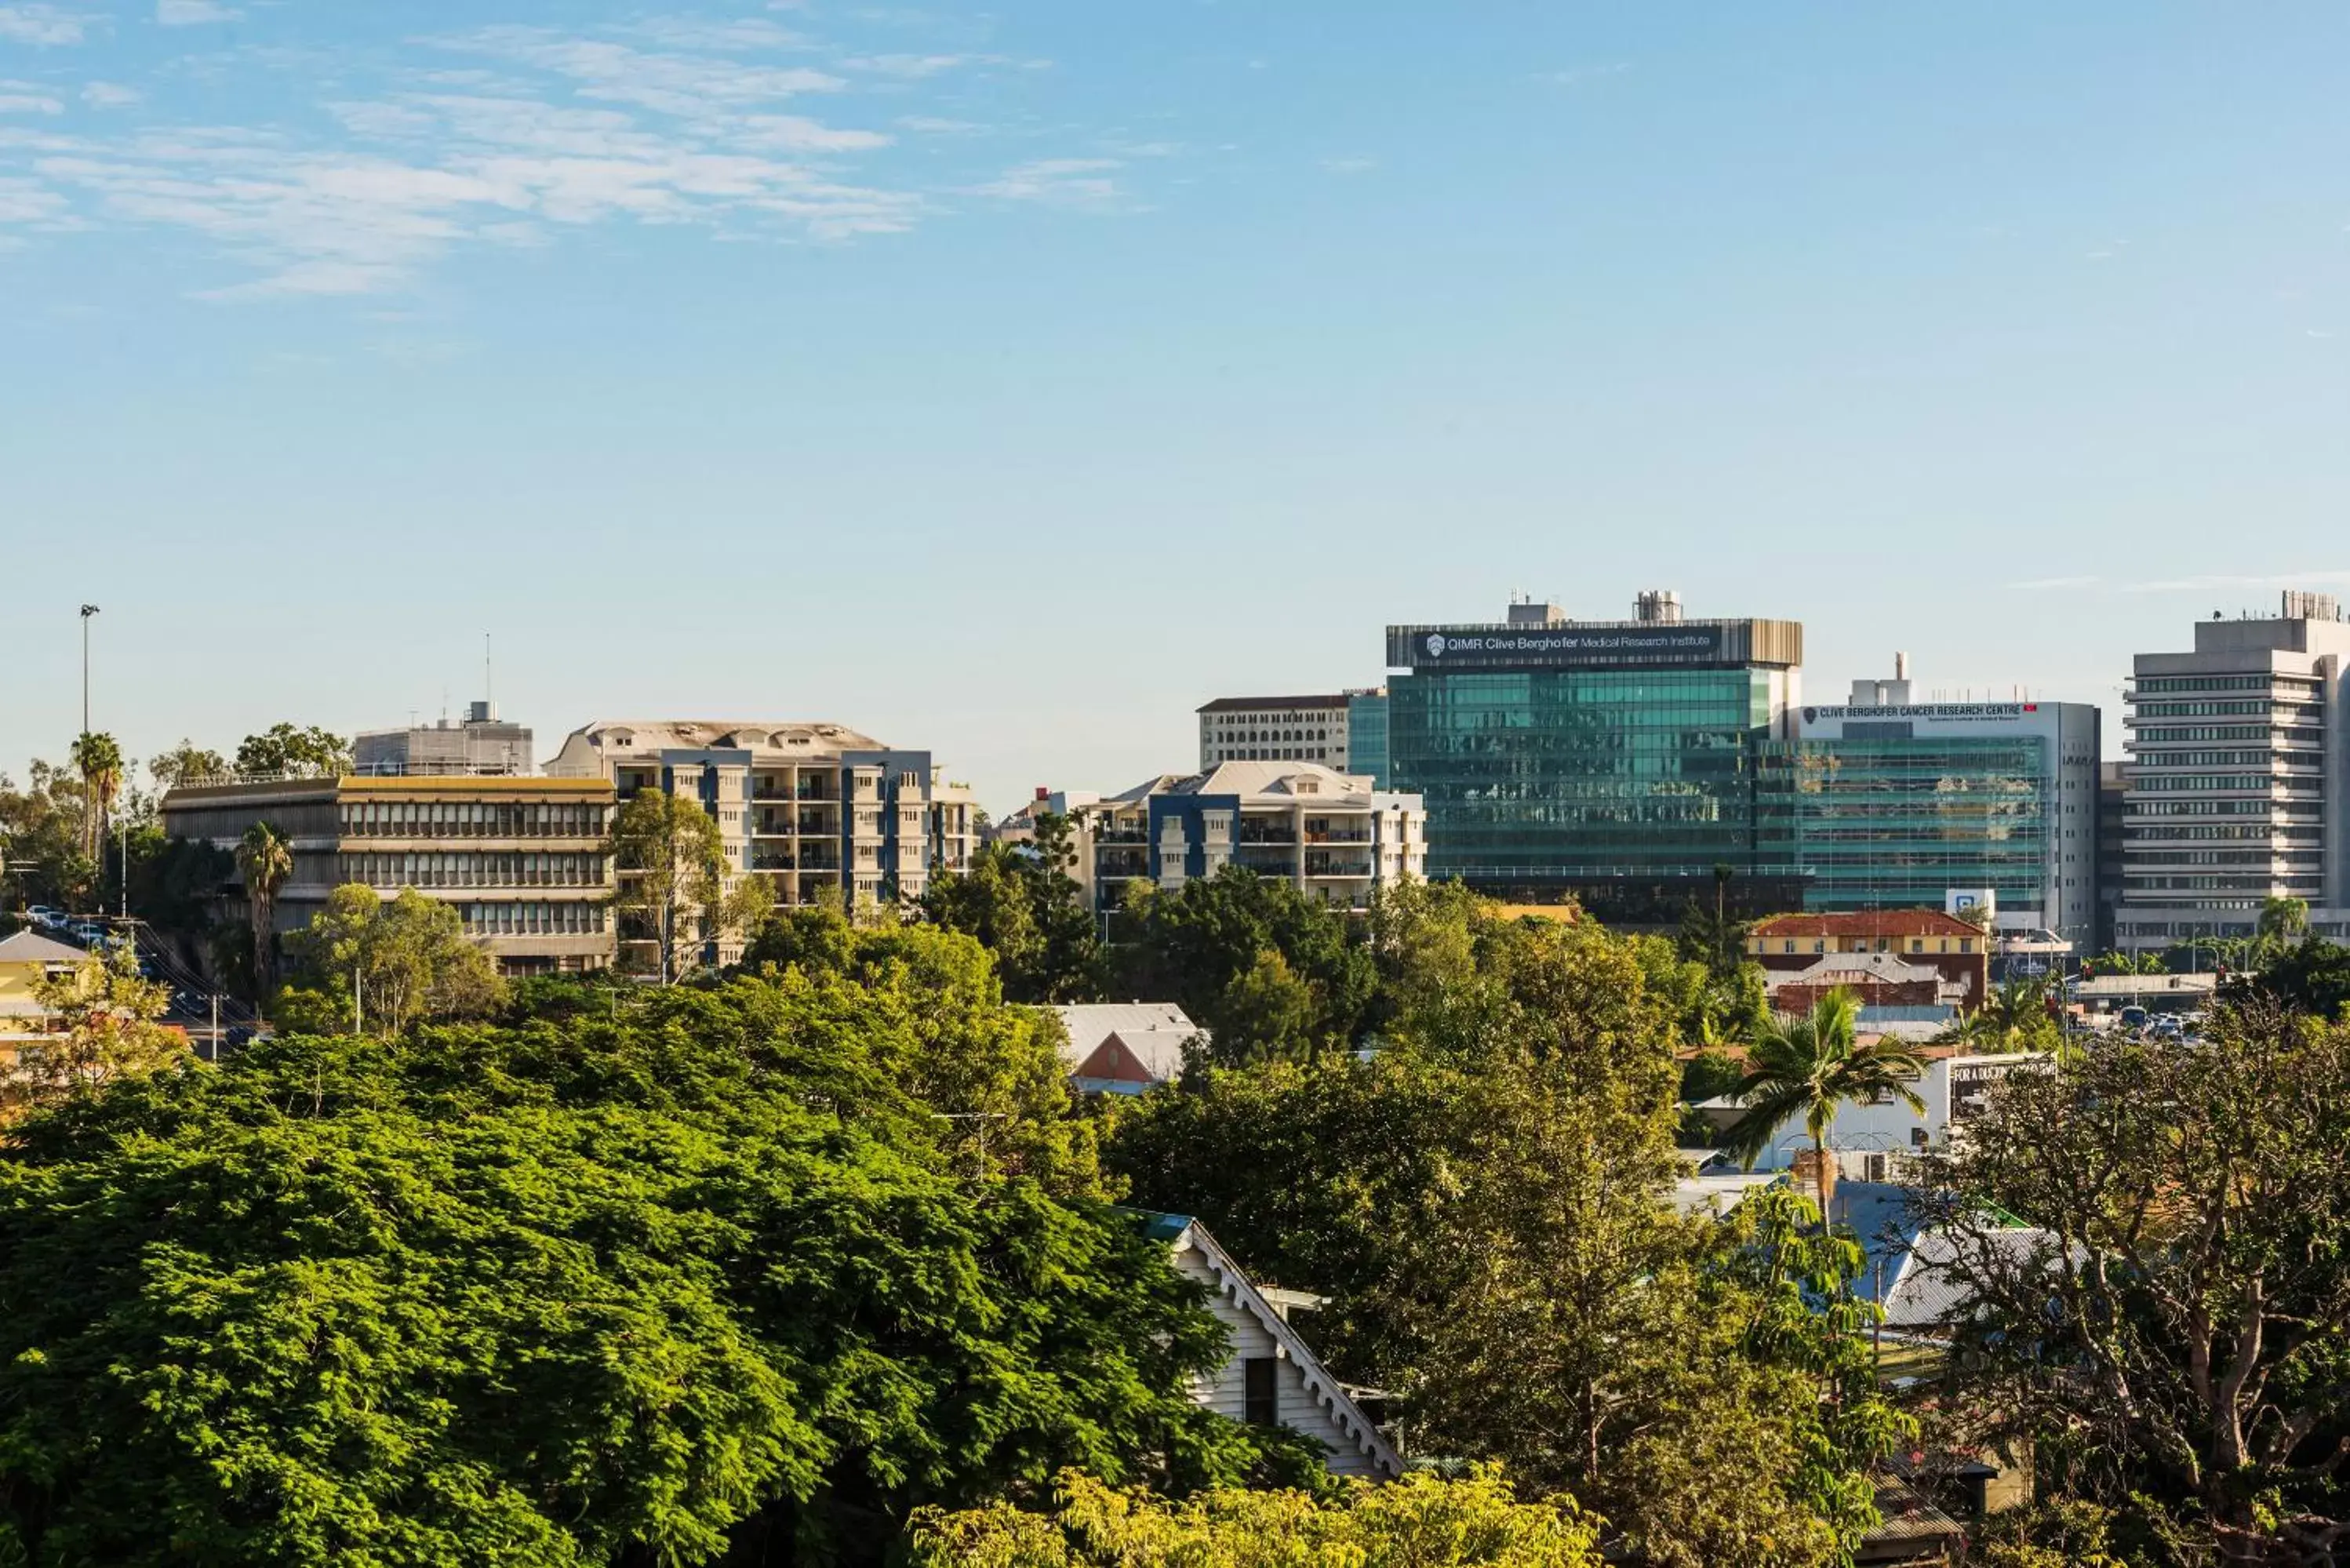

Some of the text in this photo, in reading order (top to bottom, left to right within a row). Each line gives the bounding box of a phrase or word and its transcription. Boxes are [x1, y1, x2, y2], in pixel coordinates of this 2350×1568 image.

[1447, 635, 1710, 651] QIMR Clive Berghofer Medical Research Institute
[1820, 704, 2020, 719] CLIVE BERGHOFER CANCER RESEARCH CENTRE
[1954, 1068, 1970, 1082] FOR
